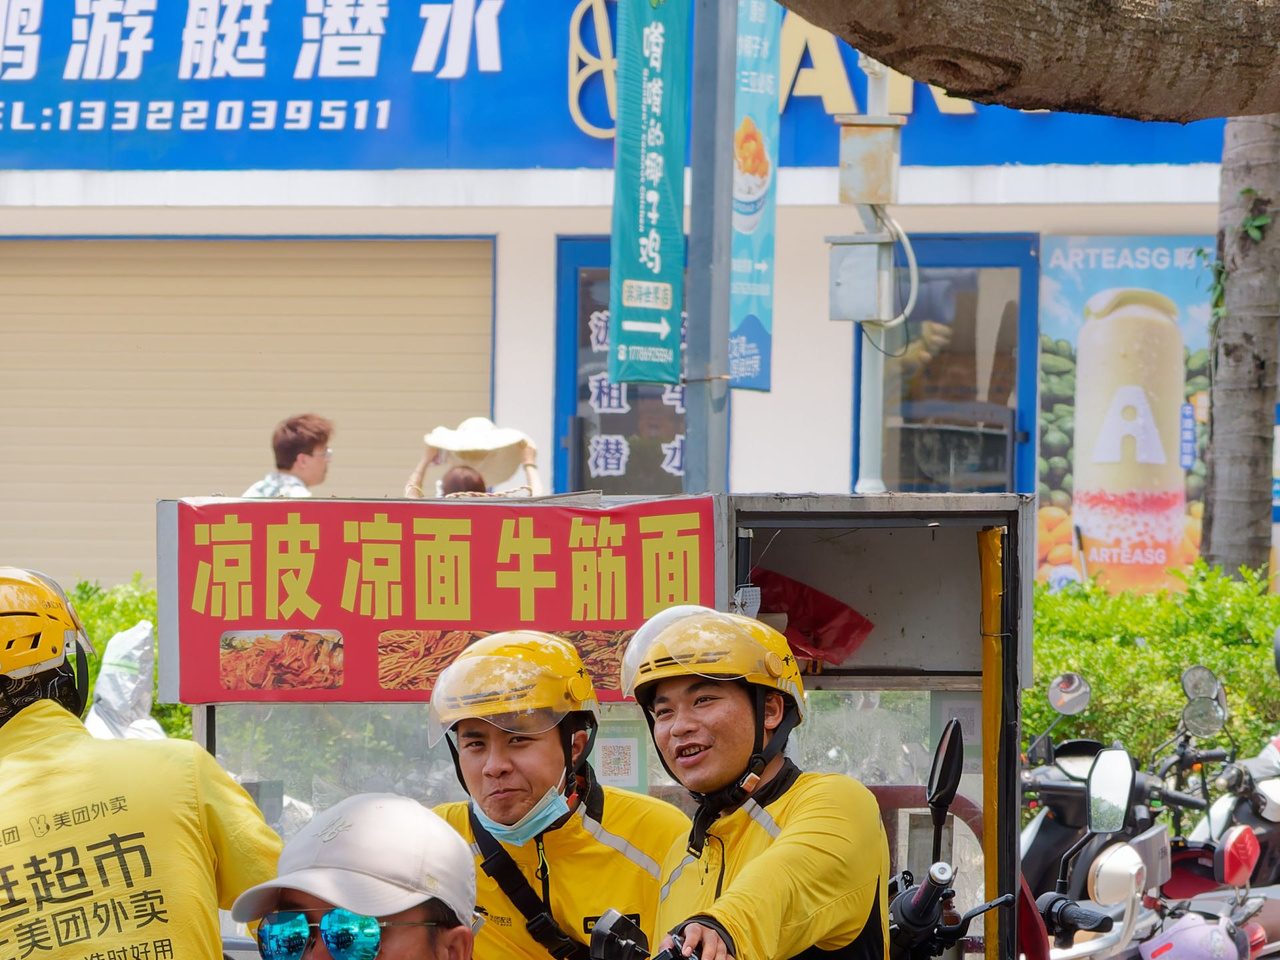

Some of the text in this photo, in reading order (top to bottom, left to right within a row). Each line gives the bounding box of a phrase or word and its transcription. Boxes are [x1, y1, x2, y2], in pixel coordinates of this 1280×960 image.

[1049, 248, 1169, 271] ARTEASG
[192, 512, 701, 622] 凉皮 凉面 牛筋面
[1089, 547, 1167, 565] ARTEASG
[52, 795, 128, 831] 美团外卖
